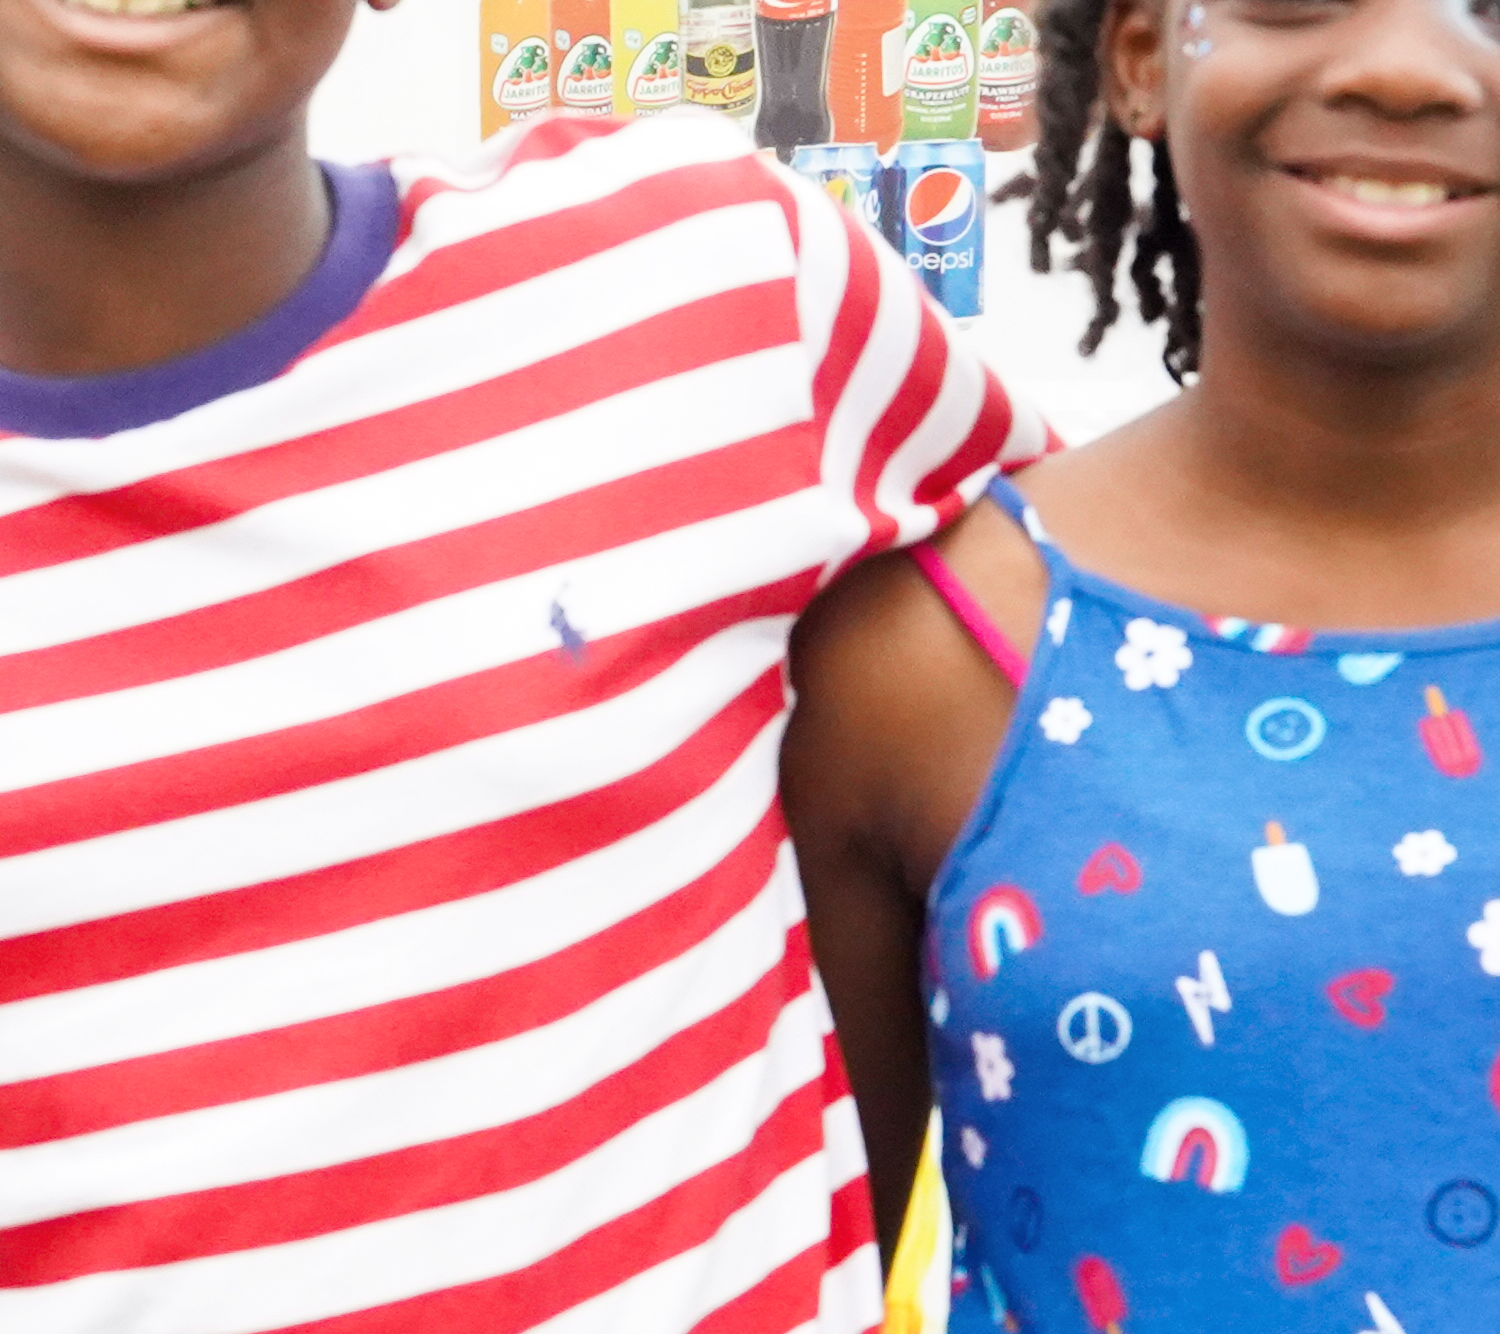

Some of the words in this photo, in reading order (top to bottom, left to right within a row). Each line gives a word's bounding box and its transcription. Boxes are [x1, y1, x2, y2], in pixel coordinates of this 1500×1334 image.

[910, 63, 964, 77] JARRITOS
[505, 83, 549, 99] JARRITO
[567, 82, 612, 96] JARRITO
